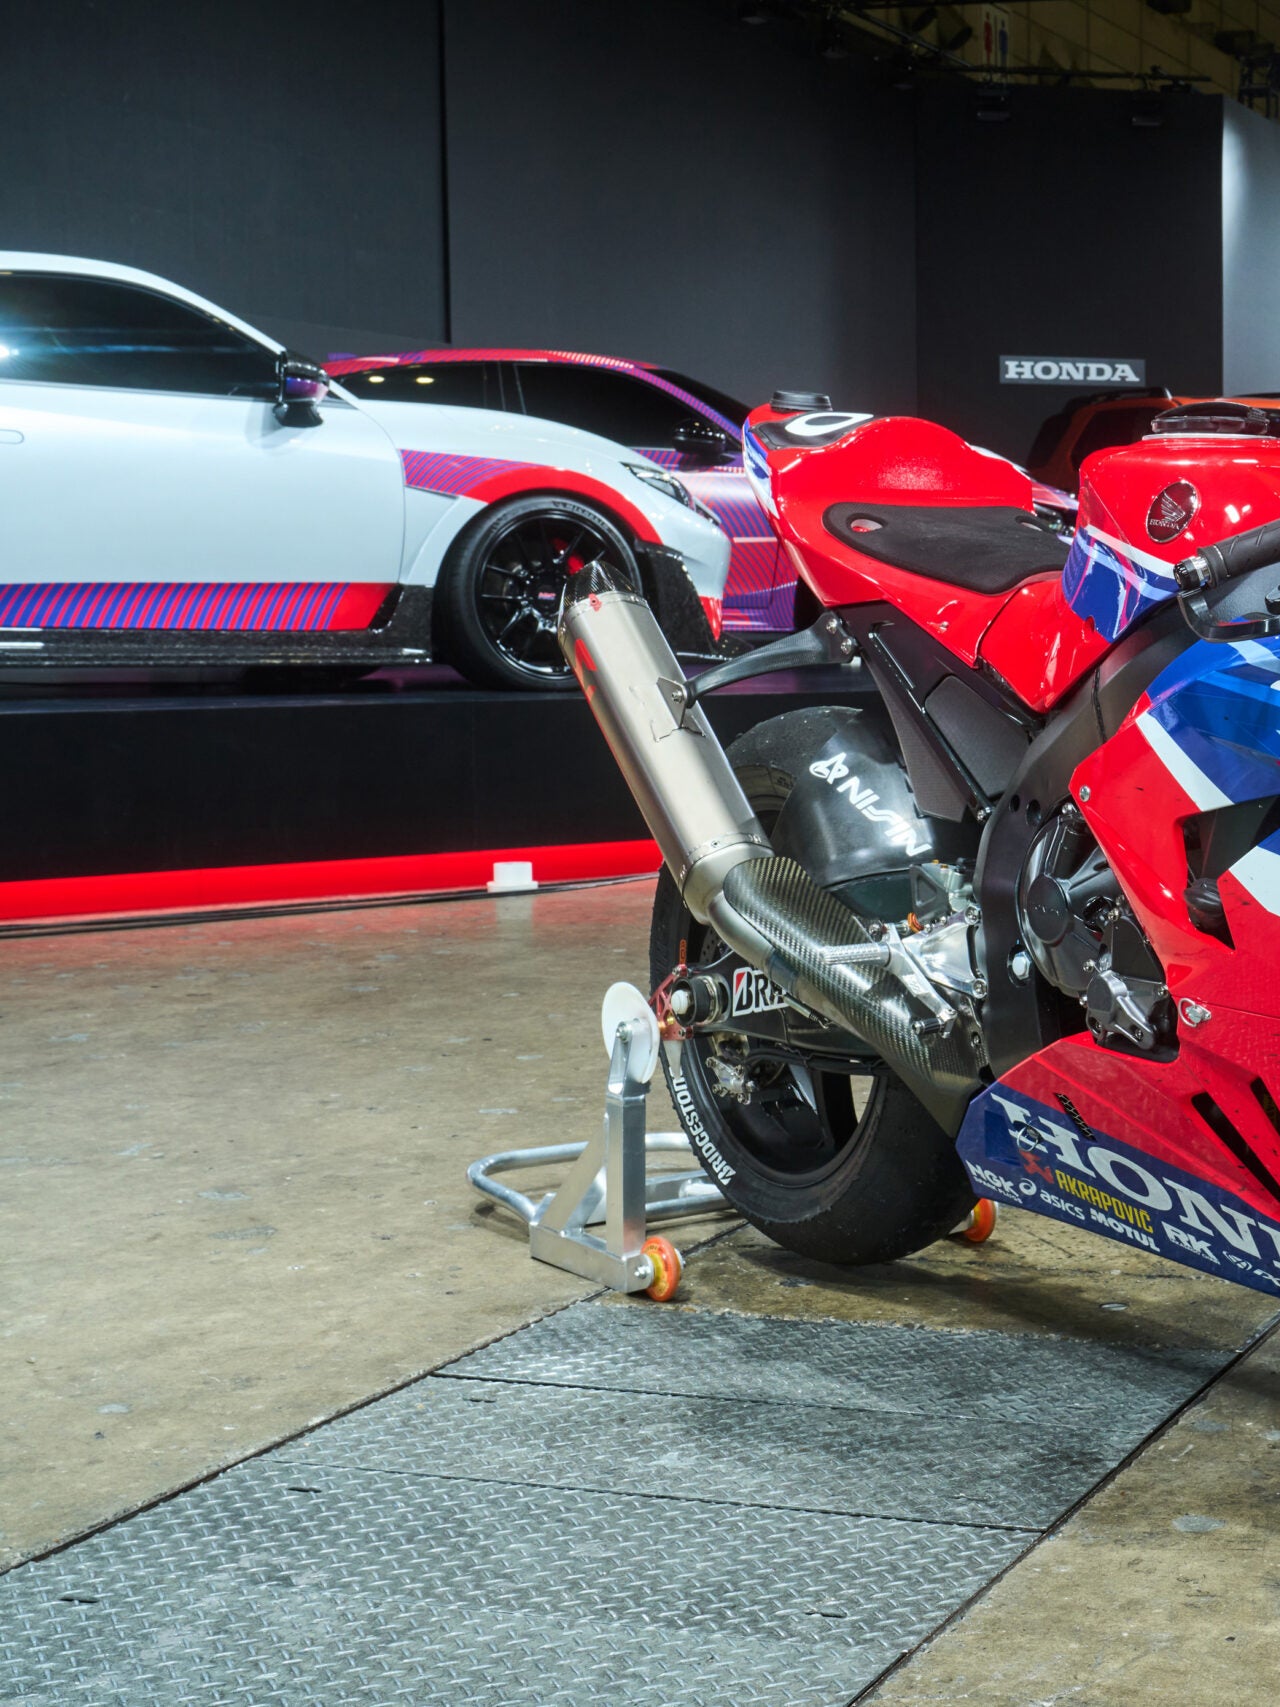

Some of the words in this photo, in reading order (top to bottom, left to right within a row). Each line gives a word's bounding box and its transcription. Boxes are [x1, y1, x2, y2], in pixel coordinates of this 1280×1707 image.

[1004, 360, 1140, 382] HONDA
[965, 1159, 1020, 1198] NGK
[1039, 1189, 1086, 1221] asics
[1090, 1206, 1161, 1253] MOTUL
[1161, 1221, 1220, 1265] RK
